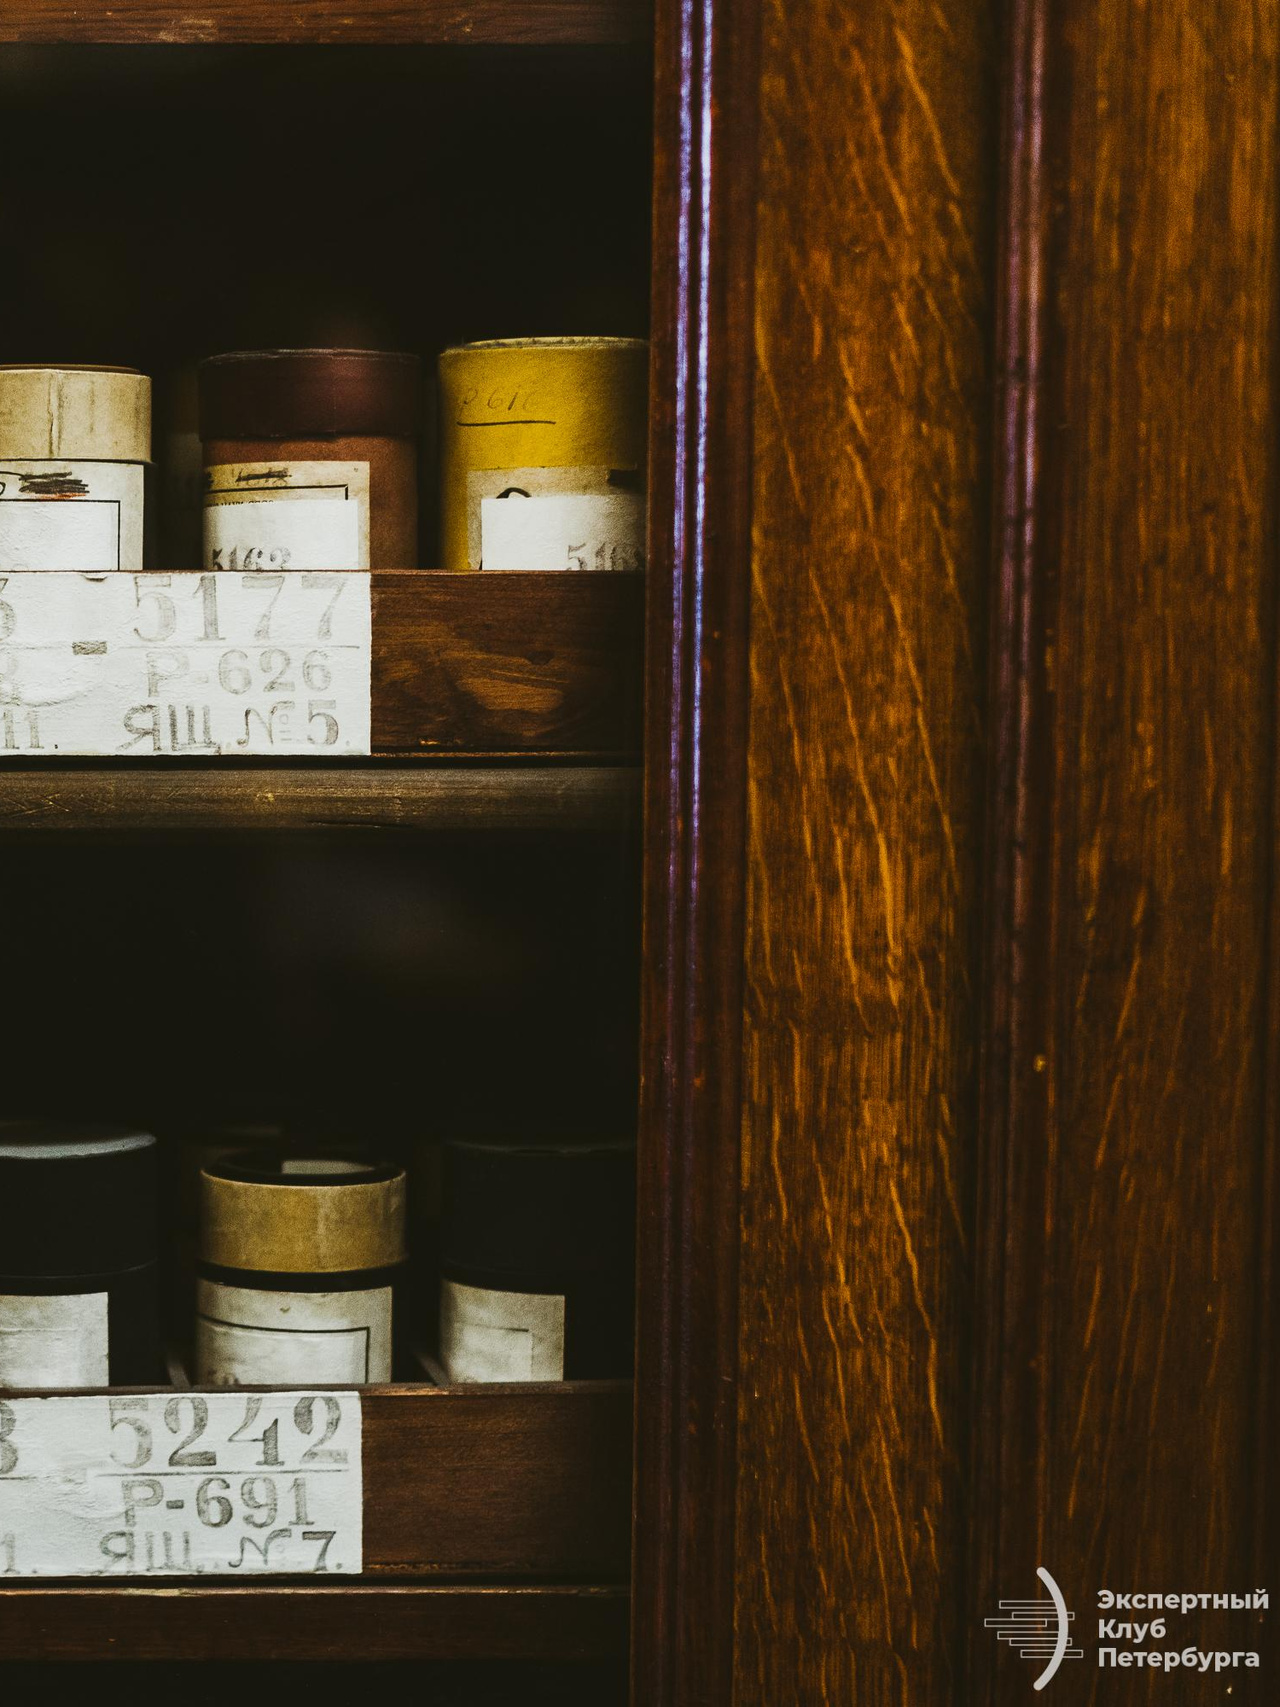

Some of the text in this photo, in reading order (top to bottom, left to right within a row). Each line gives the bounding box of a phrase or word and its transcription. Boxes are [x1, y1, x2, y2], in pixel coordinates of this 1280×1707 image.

[133, 575, 347, 642] 5177
[146, 649, 332, 698] Р-626
[109, 1397, 349, 1469] 5242
[122, 1477, 315, 1529] Р-691
